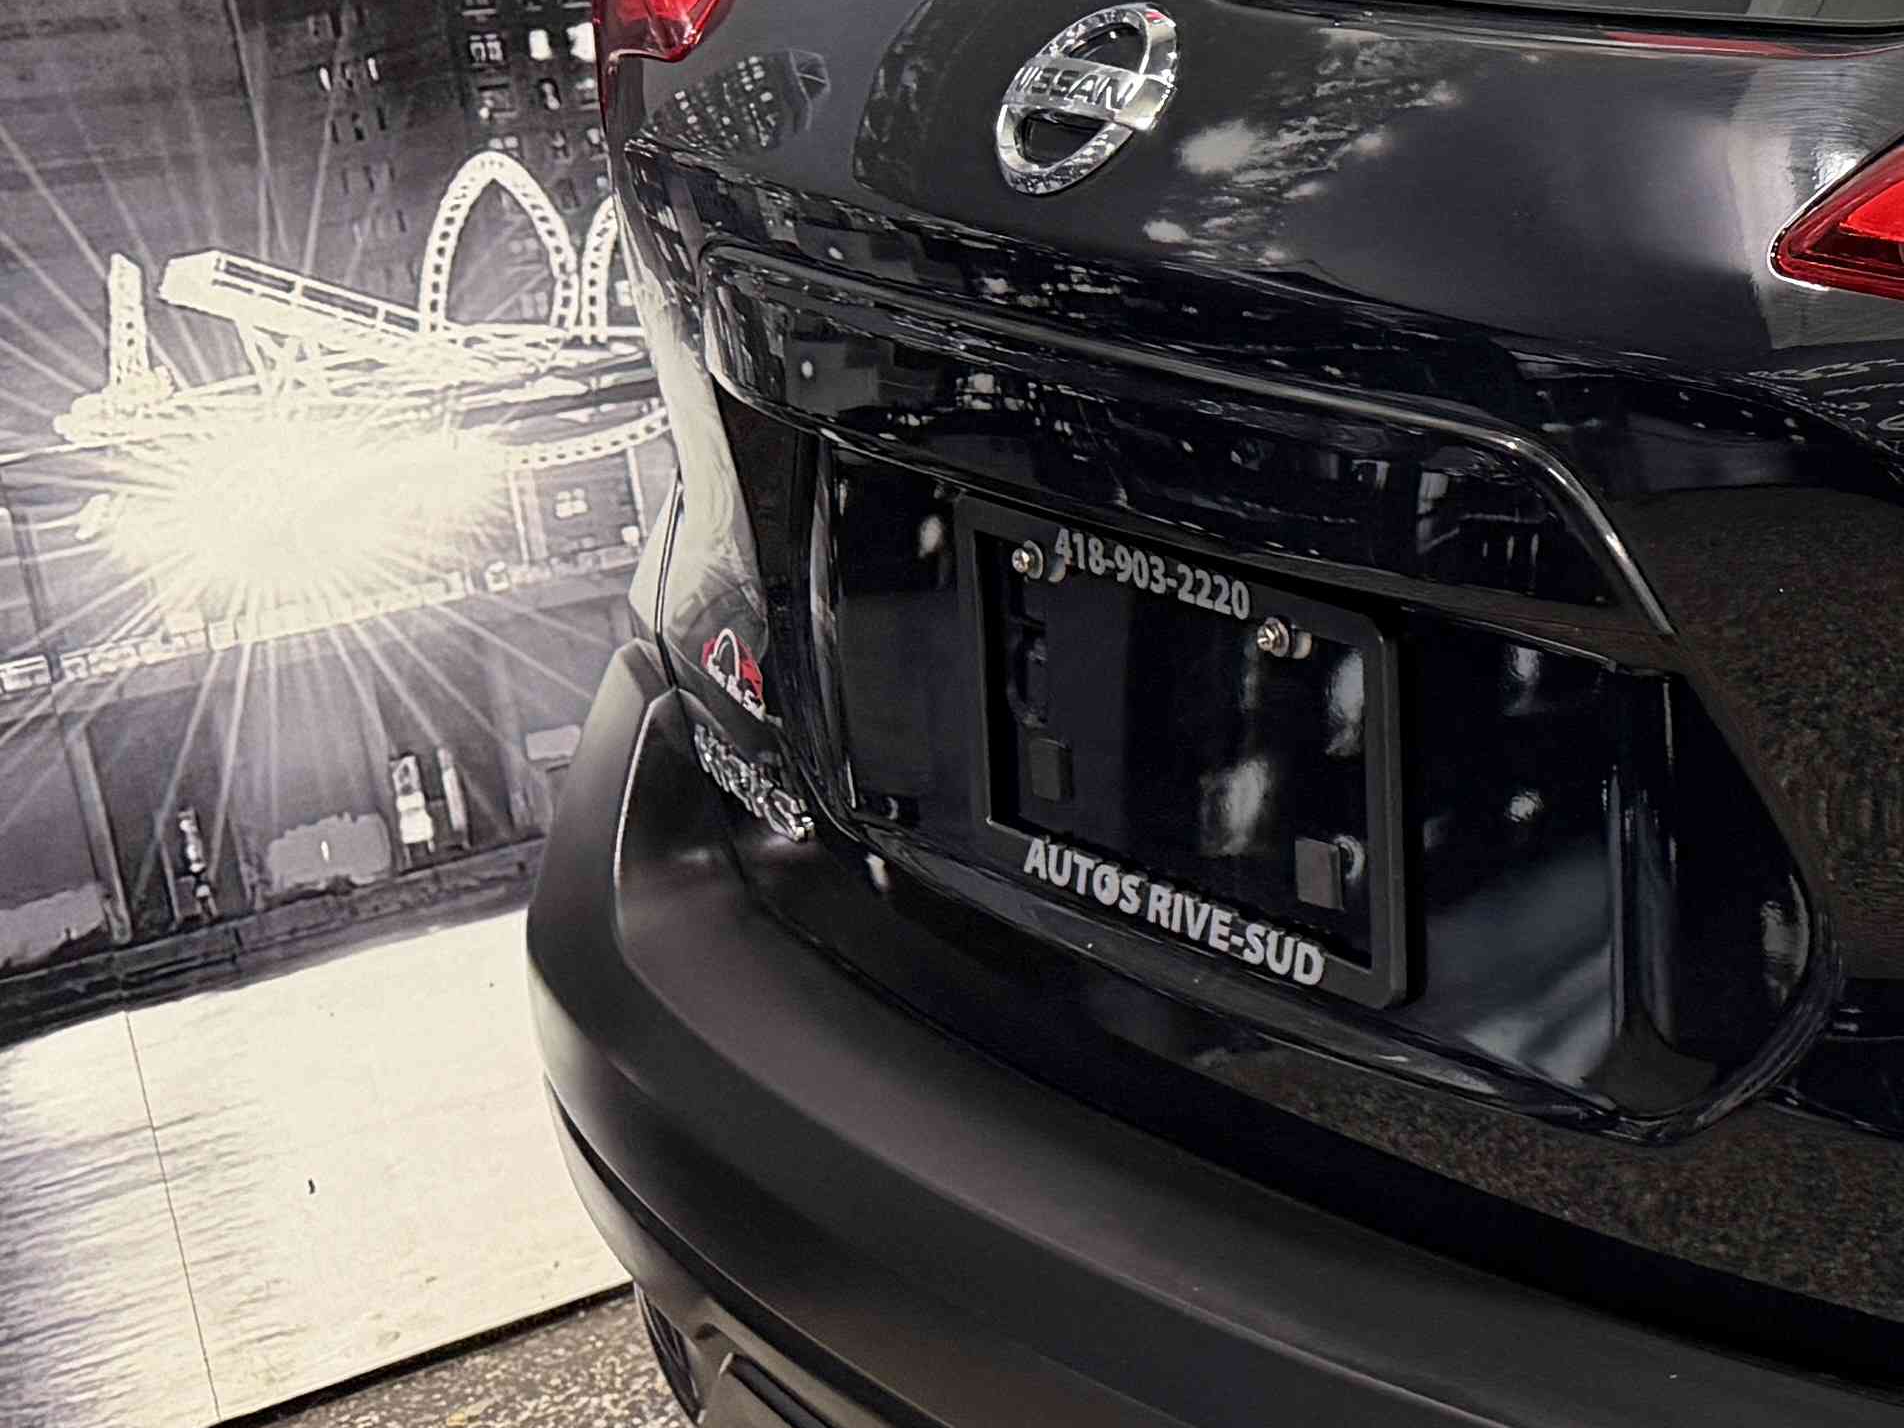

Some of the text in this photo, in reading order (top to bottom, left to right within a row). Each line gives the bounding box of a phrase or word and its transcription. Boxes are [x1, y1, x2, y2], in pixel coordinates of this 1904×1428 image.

[1014, 66, 1142, 112] NISSAN
[1054, 527, 1250, 620] 418-903-2220
[1023, 836, 1326, 986] AUTOS RIVE-SUD
